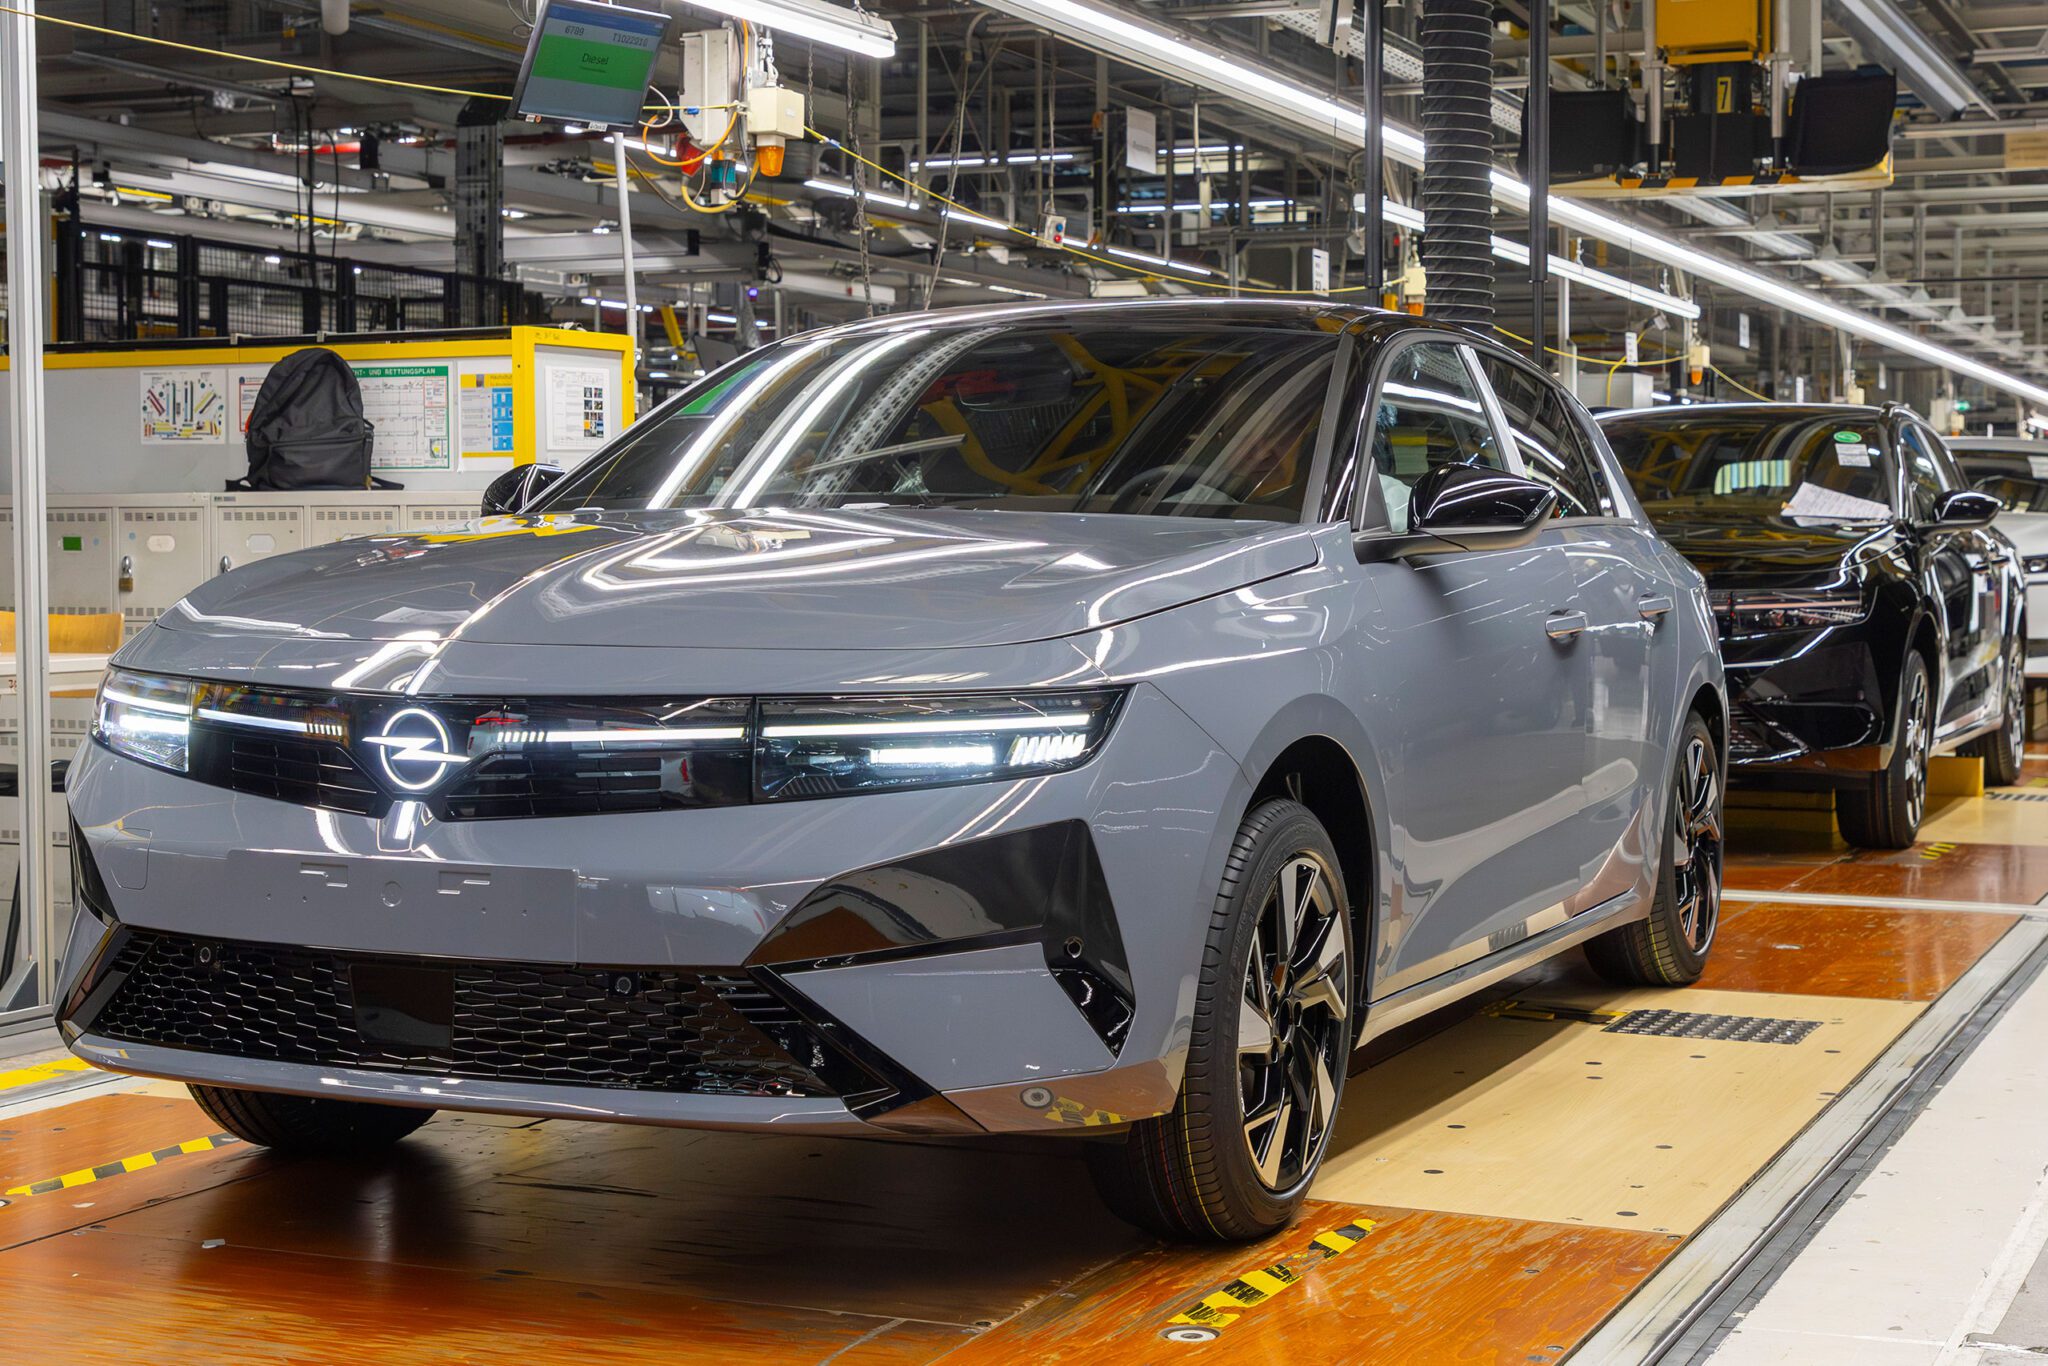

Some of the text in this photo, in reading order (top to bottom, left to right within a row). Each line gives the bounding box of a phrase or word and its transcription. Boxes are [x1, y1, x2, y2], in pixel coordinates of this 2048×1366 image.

[582, 52, 609, 65] Diesel
[1719, 80, 1729, 110] 7
[384, 367, 436, 375] RETTUNGSPLAN
